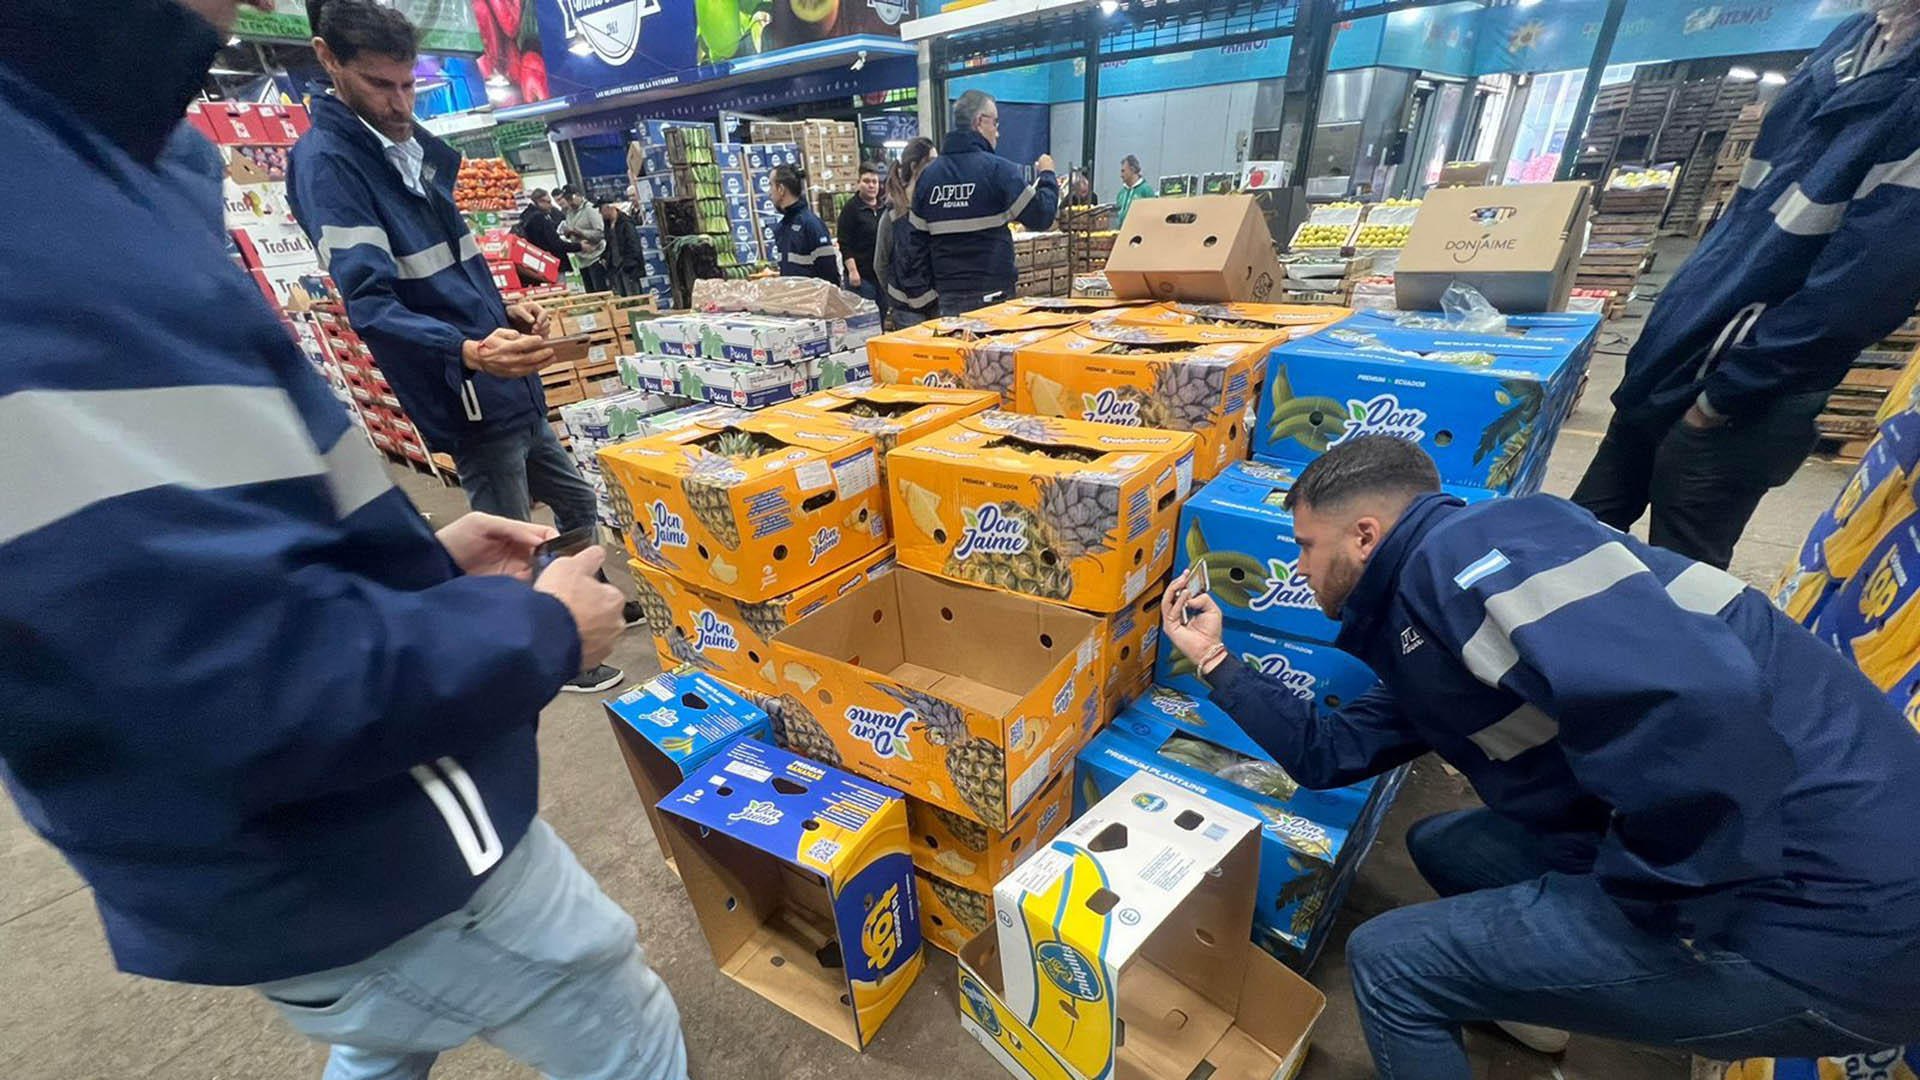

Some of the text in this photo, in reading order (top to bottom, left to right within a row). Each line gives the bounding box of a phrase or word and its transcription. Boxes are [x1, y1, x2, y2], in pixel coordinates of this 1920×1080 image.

[929, 183, 976, 205] AFIP
[943, 200, 969, 209] ADUANA
[1357, 374, 1427, 388] PREMIUM ECUADOR
[1096, 390, 1134, 416] Don
[1366, 398, 1420, 428] Don
[1084, 412, 1138, 426] Jime
[655, 501, 681, 529] Don
[977, 505, 1021, 534] Don
[652, 522, 688, 549] Jaime
[957, 529, 1025, 558] Jaime
[1253, 581, 1316, 608] Jai
[702, 610, 732, 636] Don
[695, 628, 737, 650] Jaime
[1261, 656, 1312, 687] Don
[846, 707, 916, 739] Jaime
[851, 722, 894, 755] Don
[1104, 748, 1208, 794] PREMIUM PLANTAINS
